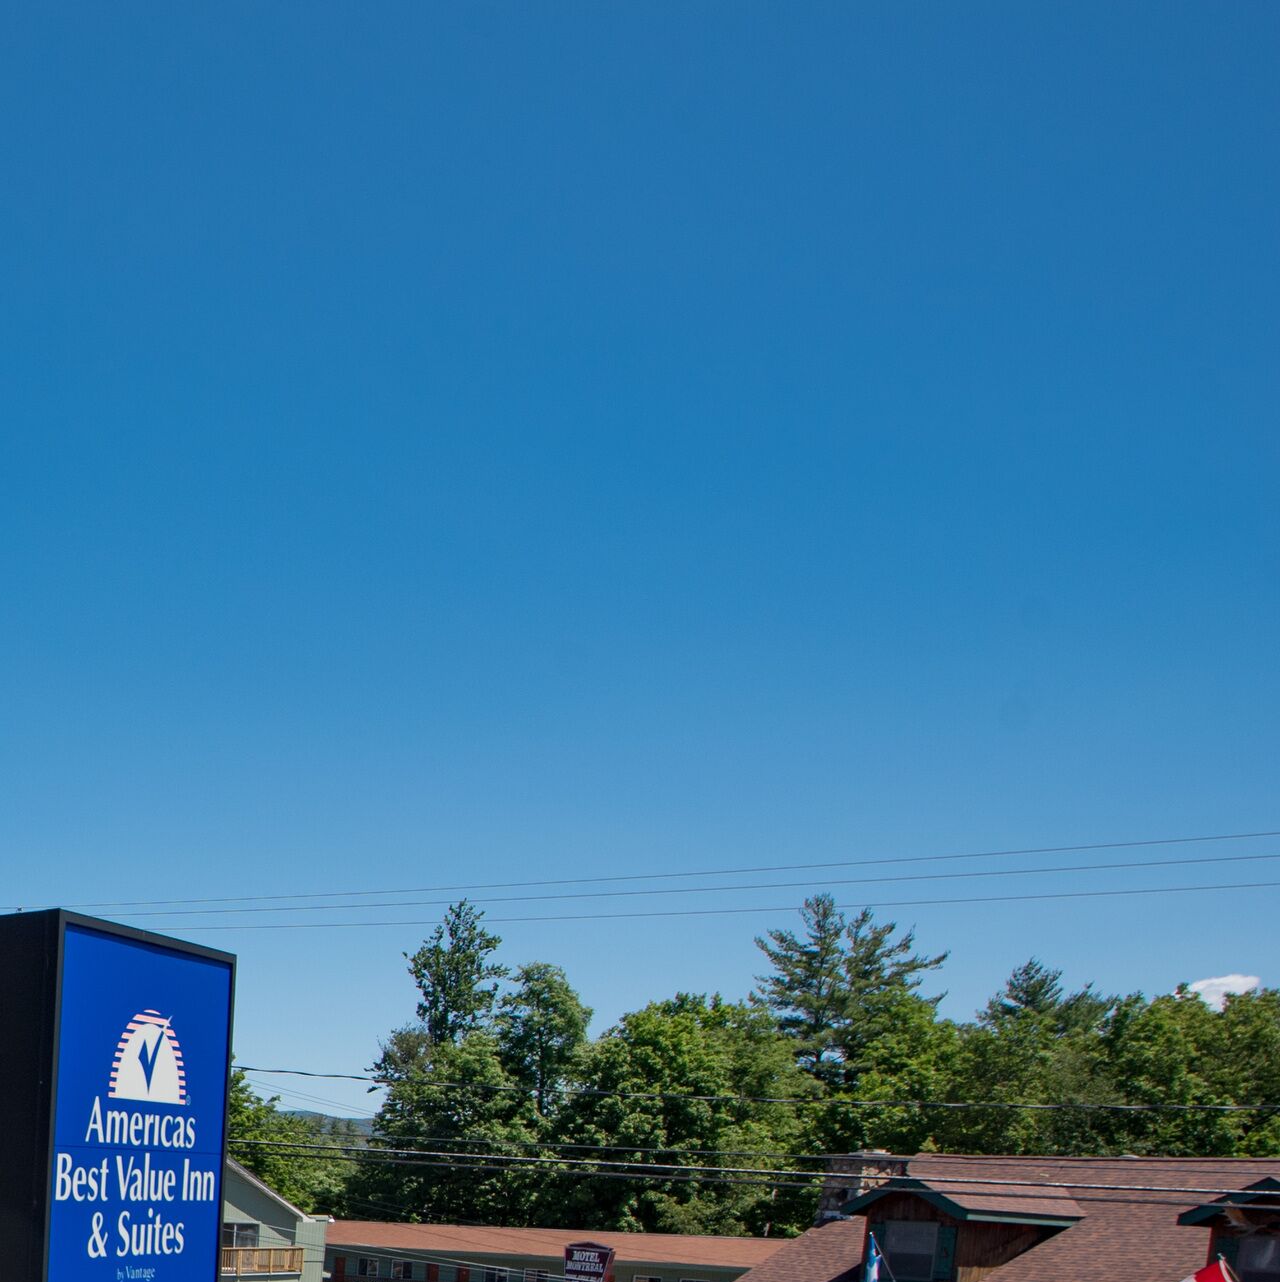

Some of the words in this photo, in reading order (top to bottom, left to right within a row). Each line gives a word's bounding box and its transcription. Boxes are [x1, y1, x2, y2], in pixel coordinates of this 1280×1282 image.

[85, 1096, 197, 1149] Americas
[55, 1152, 109, 1202] Best
[116, 1152, 177, 1202] Value
[182, 1158, 215, 1201] Inn
[87, 1211, 109, 1259] &
[116, 1207, 185, 1258] Suites
[566, 1260, 604, 1273] MONTREAL
[572, 1250, 600, 1263] MOTEL
[116, 1268, 124, 1282] by
[125, 1265, 156, 1282] Vantage
